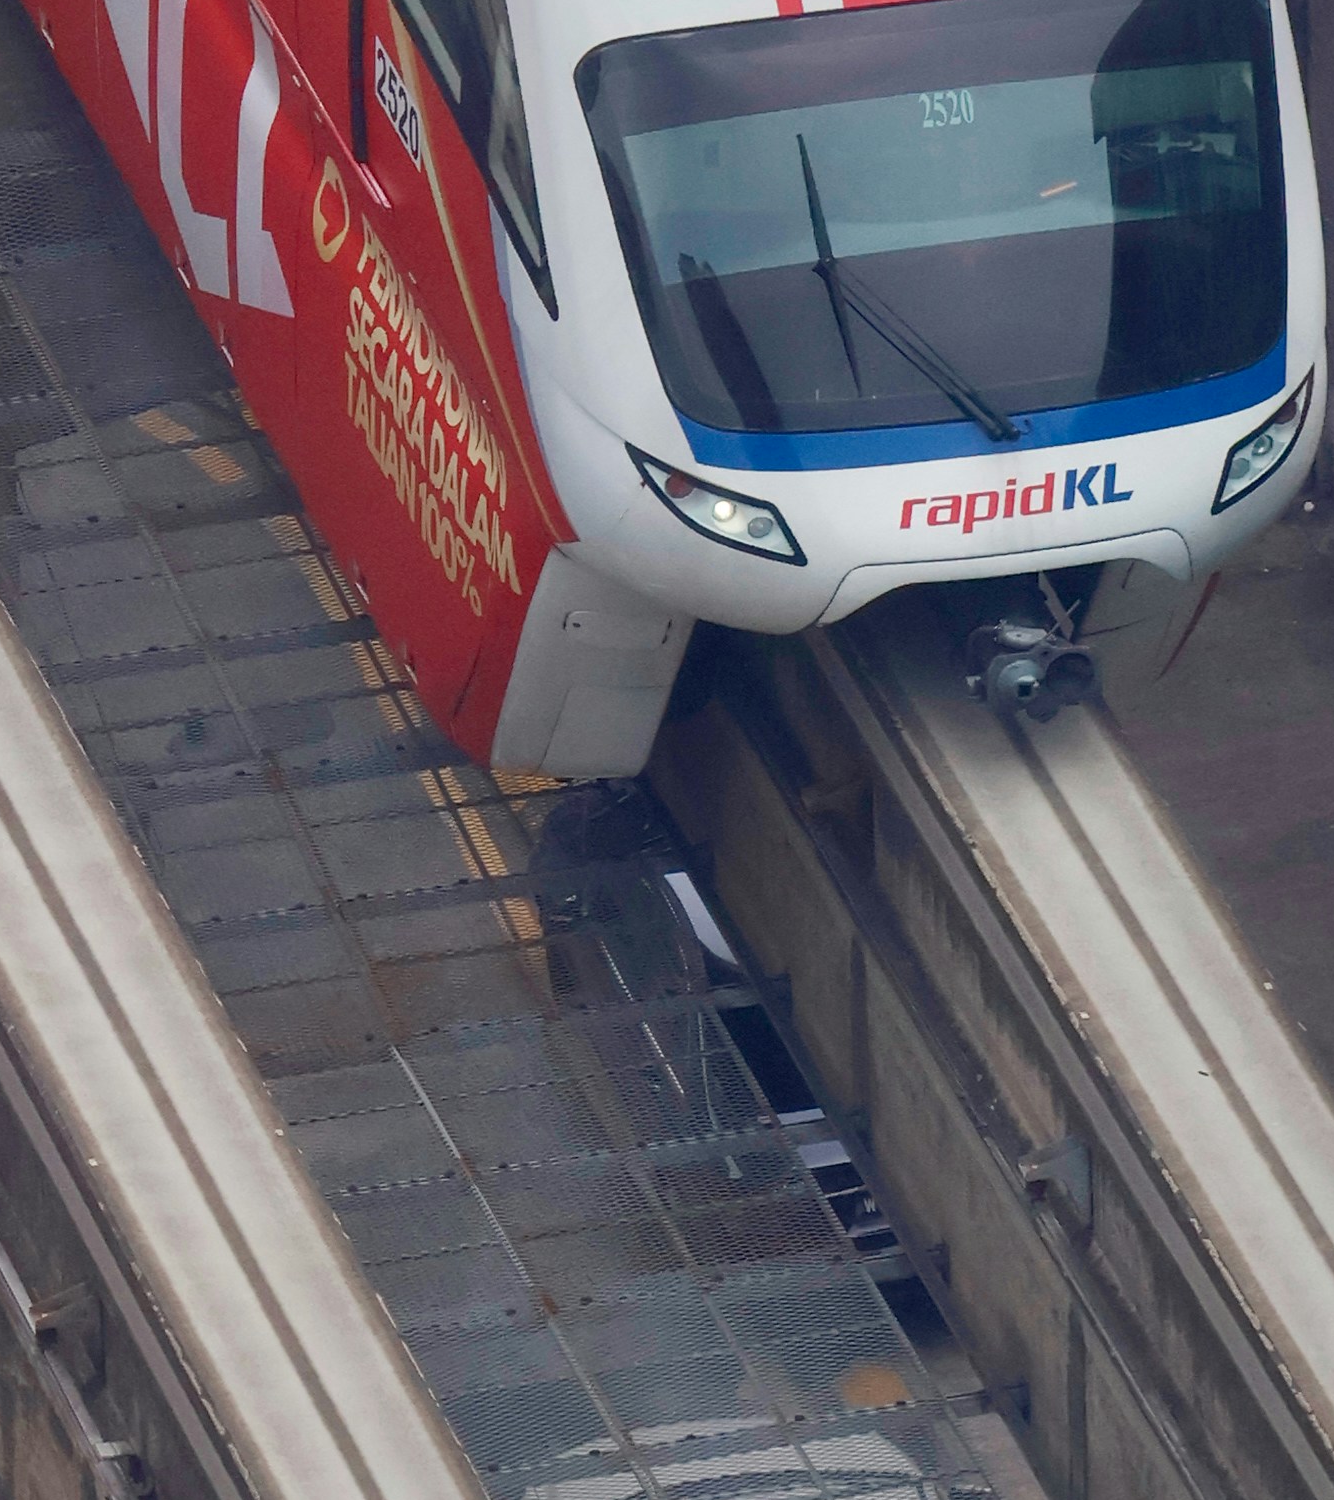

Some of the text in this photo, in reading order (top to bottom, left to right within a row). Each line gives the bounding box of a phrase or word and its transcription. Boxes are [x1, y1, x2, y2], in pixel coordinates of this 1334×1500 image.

[377, 52, 419, 162] 2520
[918, 89, 976, 129] 2520
[345, 286, 523, 596] SECARA DALAM
[356, 212, 507, 512] PERMOHONAN
[344, 351, 482, 617] TALIAN 100%
[898, 463, 1134, 534] rapidKL
